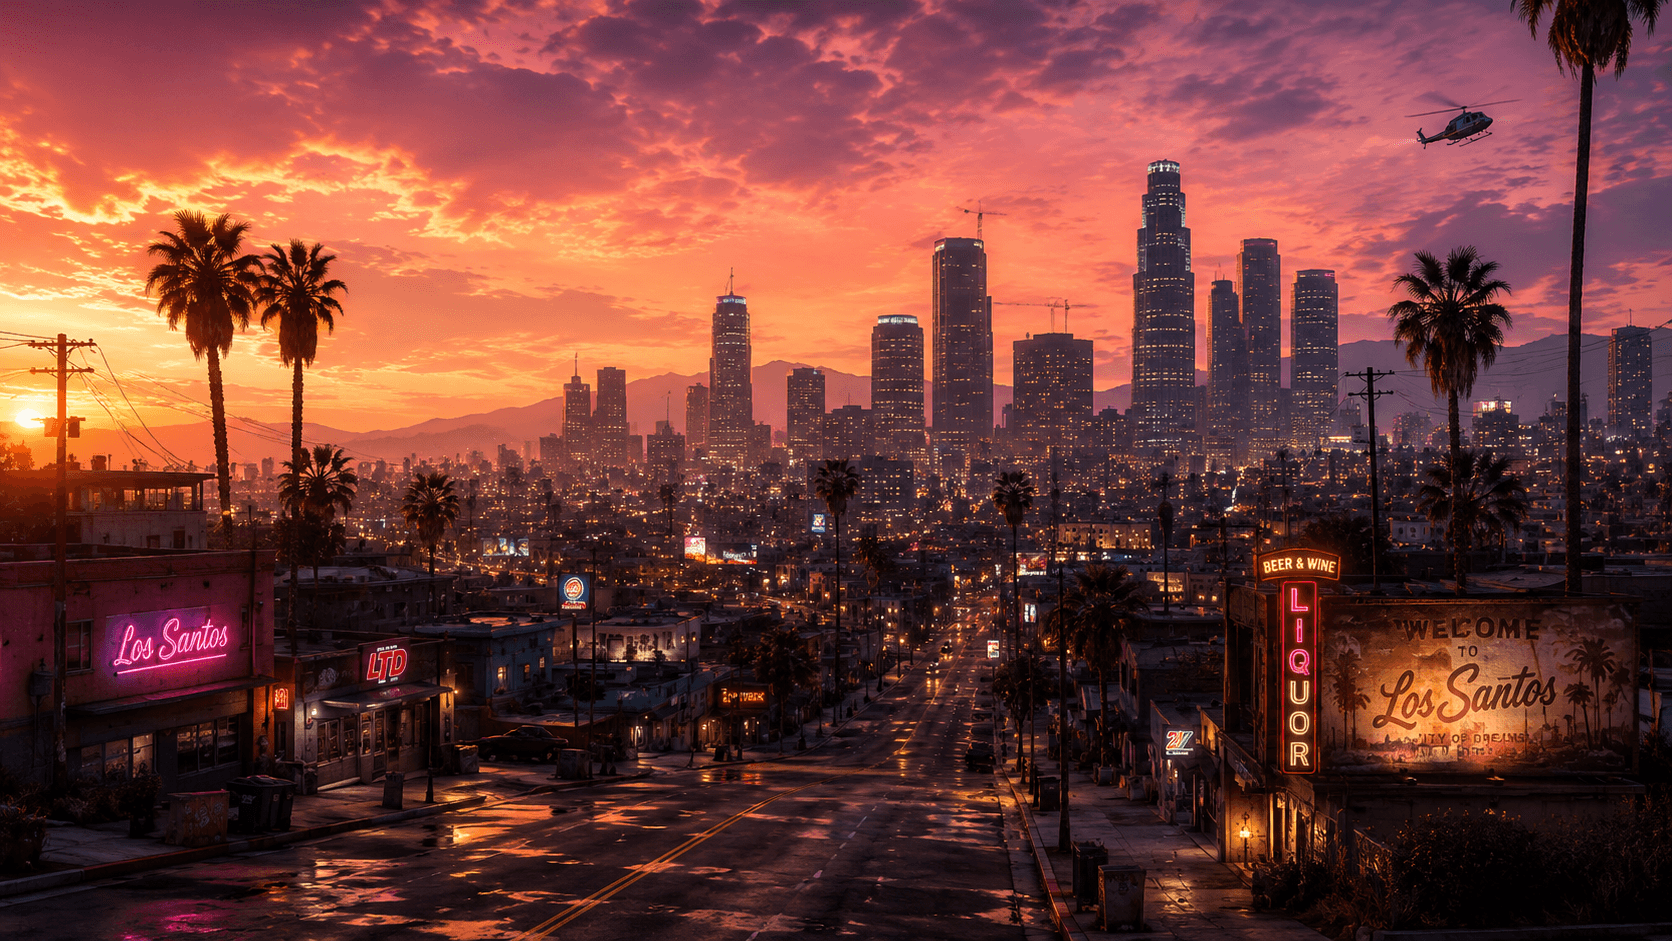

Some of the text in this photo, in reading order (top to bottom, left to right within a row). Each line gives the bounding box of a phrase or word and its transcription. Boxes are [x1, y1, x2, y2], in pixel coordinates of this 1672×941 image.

[1263, 557, 1337, 573] BEER & WINE
[113, 618, 228, 666] Los Santos
[1393, 617, 1542, 641] WELCOME
[366, 648, 408, 682] LTD
[1458, 645, 1478, 658] TO
[1289, 588, 1310, 766] LIQUOR
[1372, 662, 1556, 731] Los Santos
[1419, 733, 1446, 744] ITY
